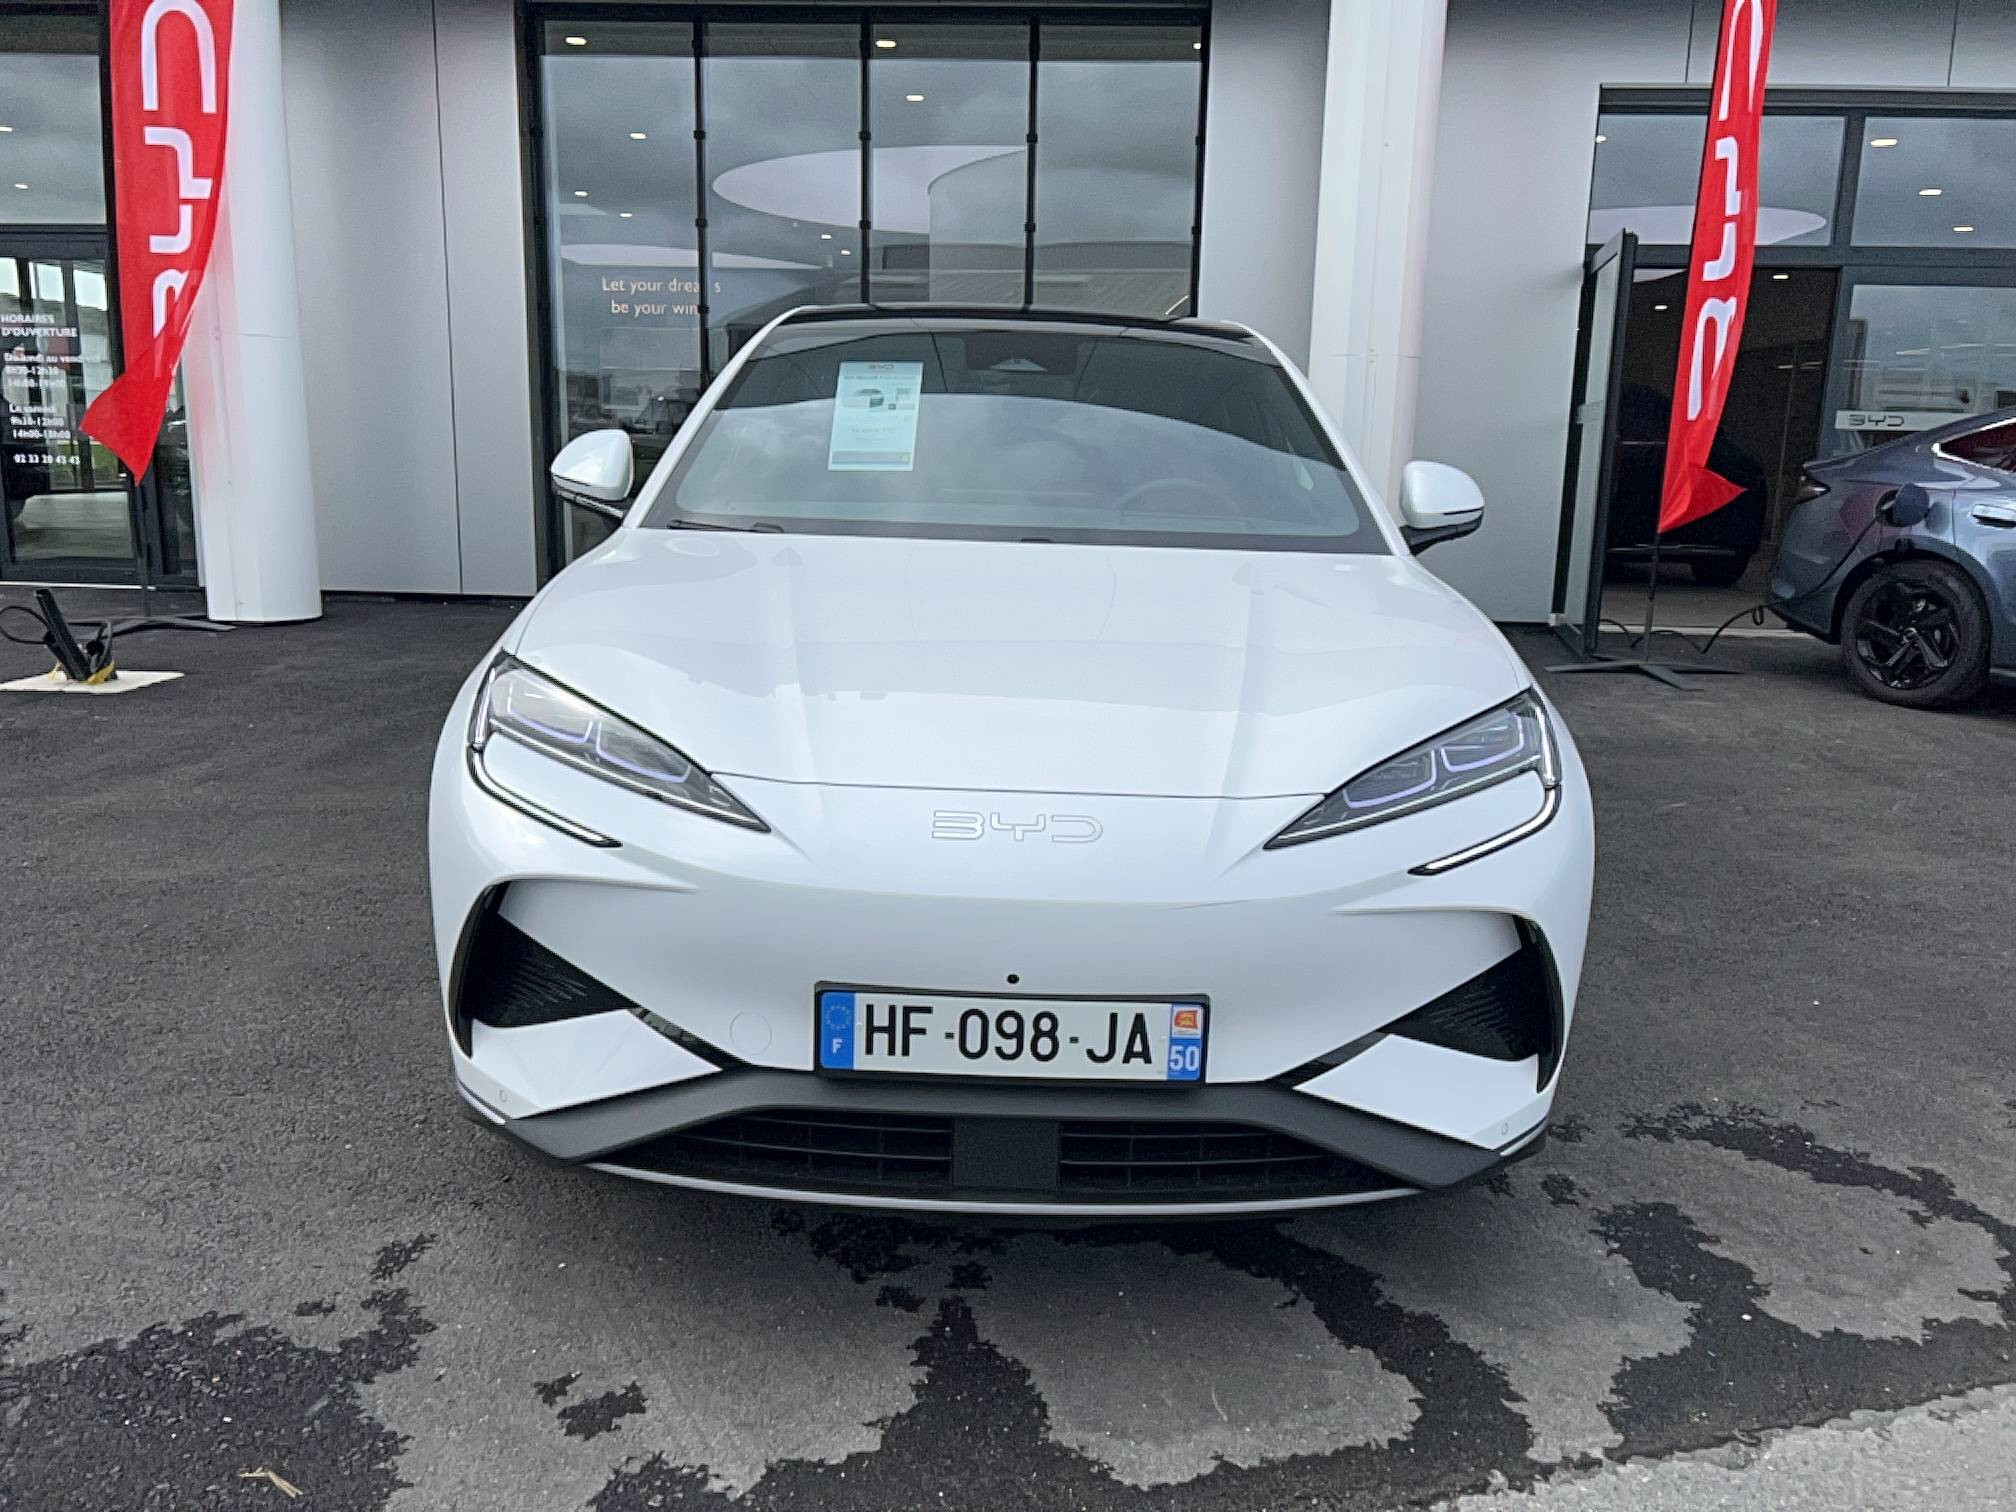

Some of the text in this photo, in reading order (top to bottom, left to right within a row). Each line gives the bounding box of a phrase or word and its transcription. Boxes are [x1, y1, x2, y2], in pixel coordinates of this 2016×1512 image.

[602, 277, 720, 295] Let your dreas
[611, 299, 629, 313] be
[634, 303, 667, 318] your
[1, 327, 78, 337] D'OUVERTURE
[1849, 414, 1905, 427] BYD
[932, 810, 1103, 843] BYD
[833, 1038, 843, 1054] F
[1169, 1045, 1200, 1071] 50
